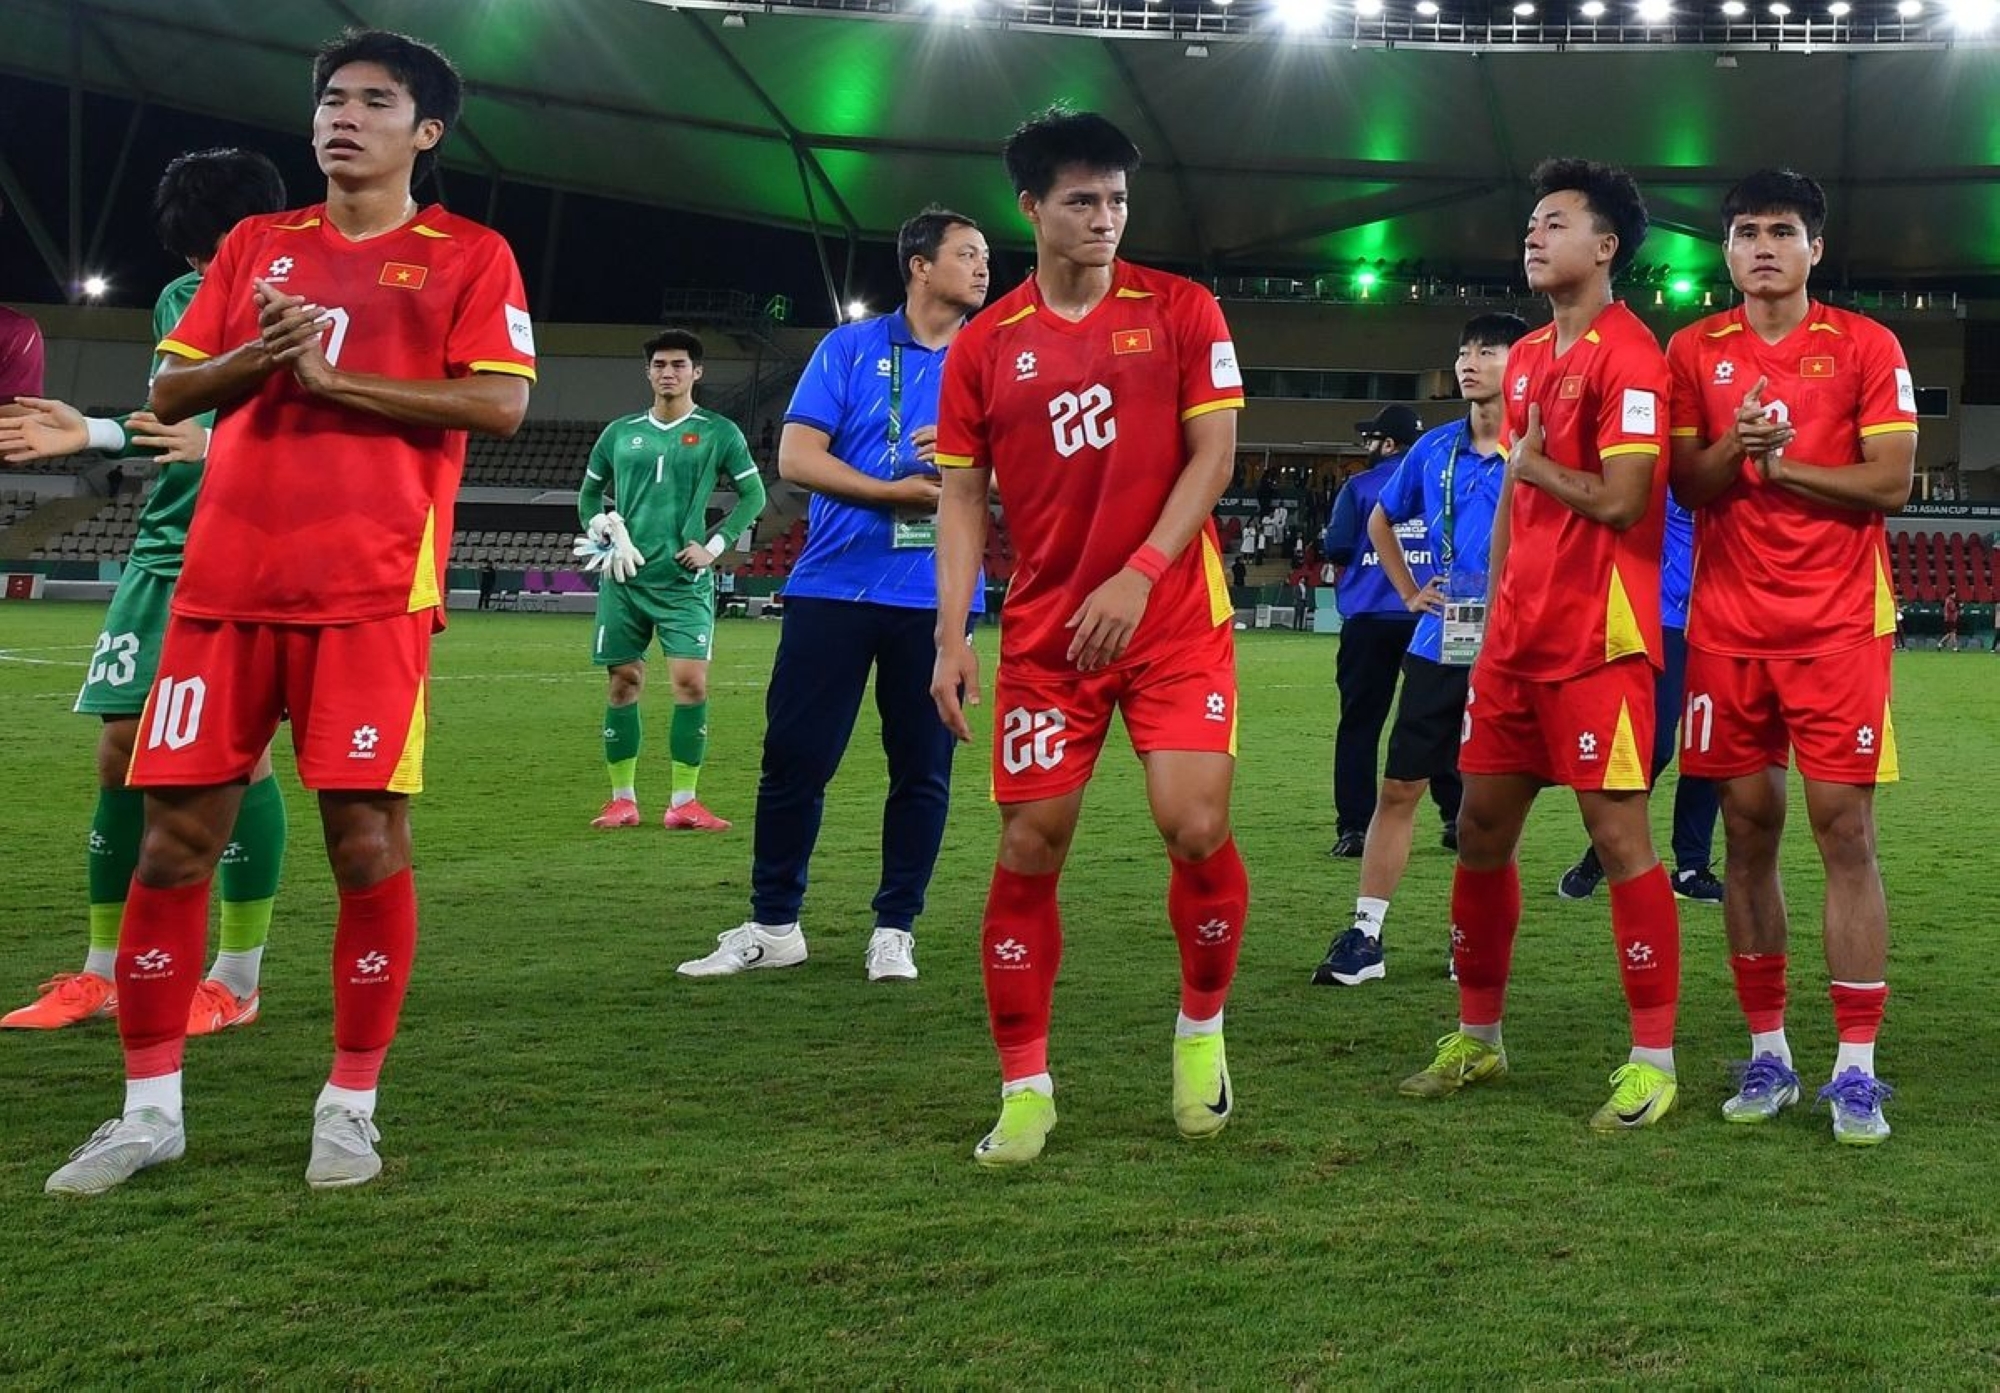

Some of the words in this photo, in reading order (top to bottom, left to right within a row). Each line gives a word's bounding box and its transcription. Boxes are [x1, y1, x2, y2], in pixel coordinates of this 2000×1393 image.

[1047, 383, 1118, 458] 22
[1626, 403, 1652, 418] AFC
[656, 454, 665, 483] 1
[1919, 504, 1948, 514] ASIAN
[1948, 506, 1969, 514] CUP
[87, 631, 140, 686] 23
[597, 624, 605, 653] 1
[148, 675, 206, 751] 10
[1003, 706, 1067, 775] 22
[1684, 691, 1713, 753] 17
